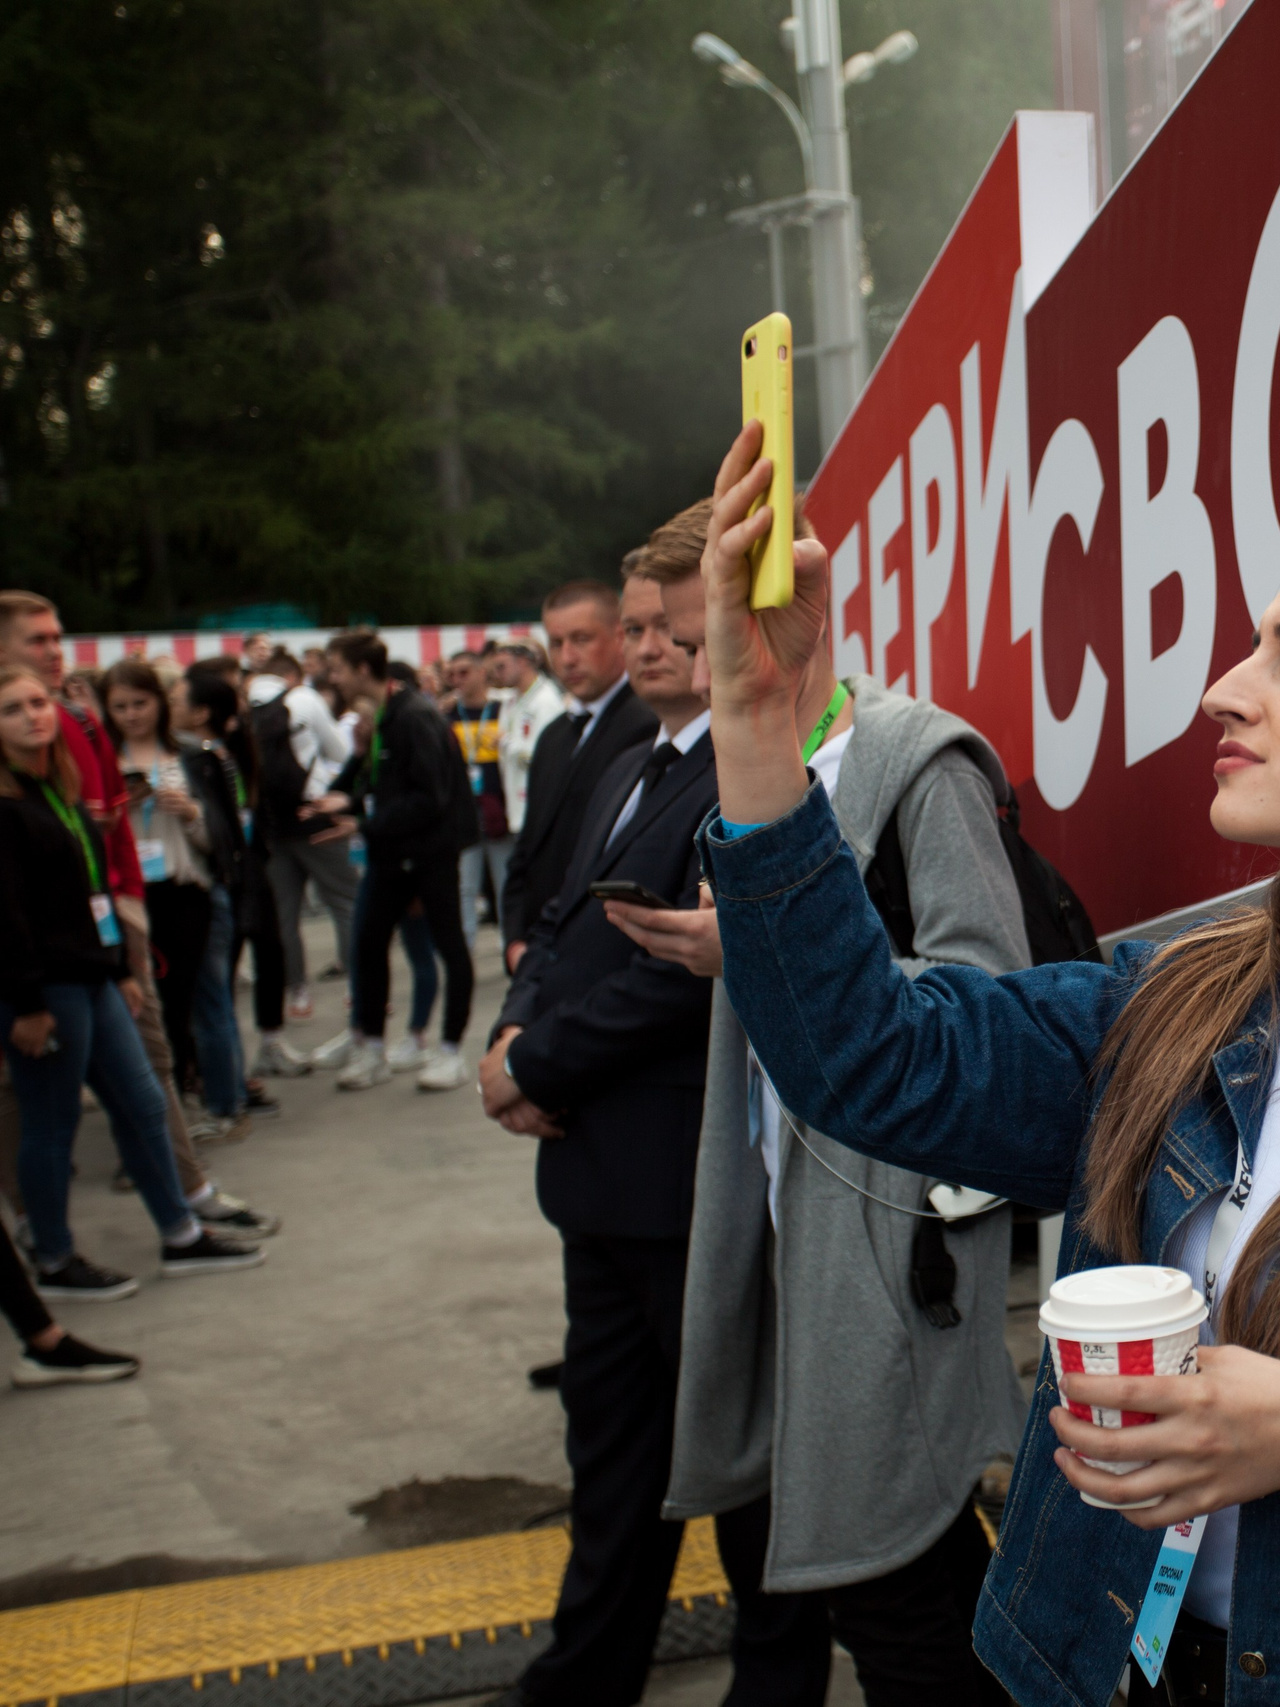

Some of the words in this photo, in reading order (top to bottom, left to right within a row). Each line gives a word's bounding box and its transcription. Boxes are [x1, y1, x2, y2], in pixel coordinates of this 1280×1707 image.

[815, 711, 834, 736] KFC
[1229, 1157, 1252, 1211] KFC
[1158, 1564, 1184, 1581] ПЕРСОНАЛ
